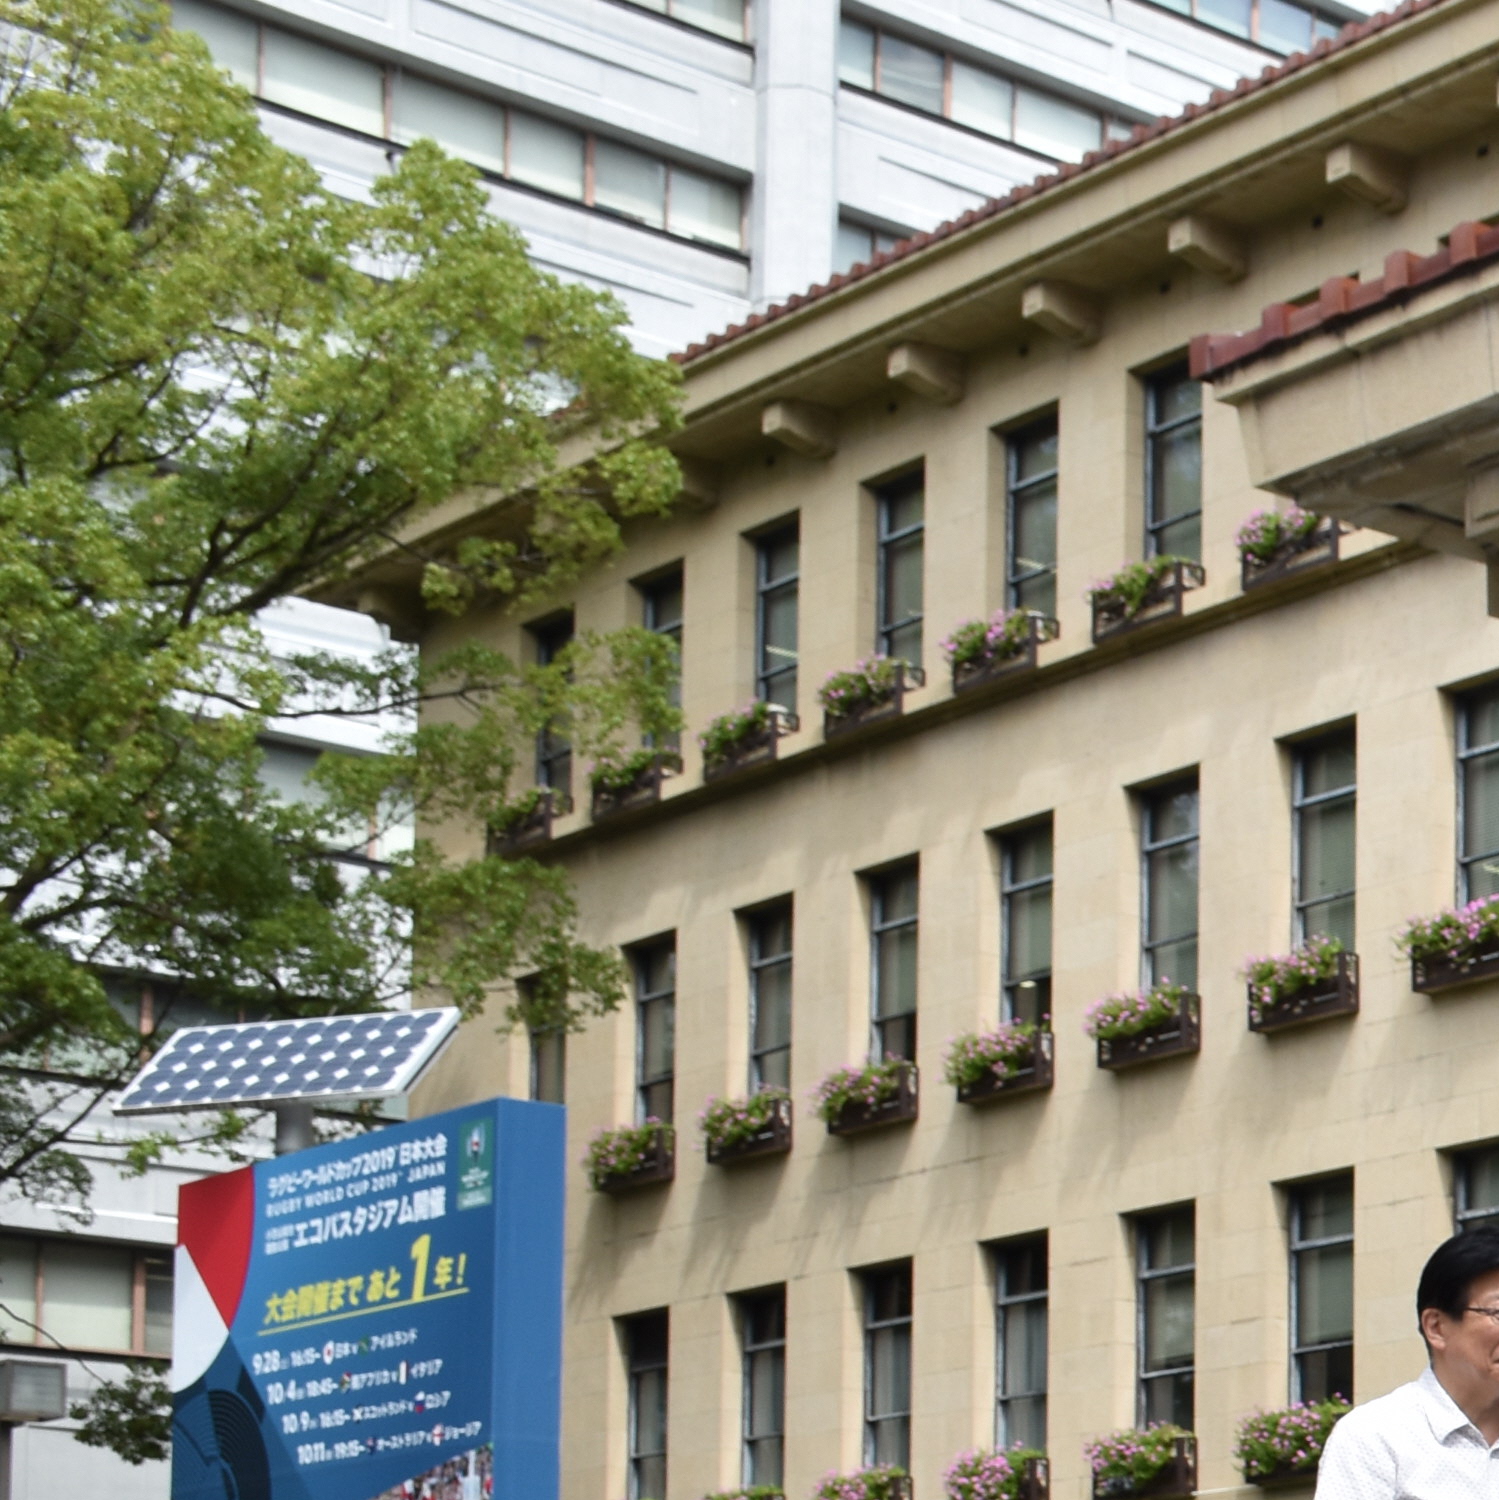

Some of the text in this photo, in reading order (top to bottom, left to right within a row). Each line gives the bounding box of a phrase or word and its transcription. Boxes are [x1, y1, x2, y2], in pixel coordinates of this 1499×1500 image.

[265, 1198, 301, 1219] RUGBY
[304, 1184, 345, 1209] WORLD
[346, 1178, 370, 1199] CUP
[407, 1160, 446, 1184] JAPAN
